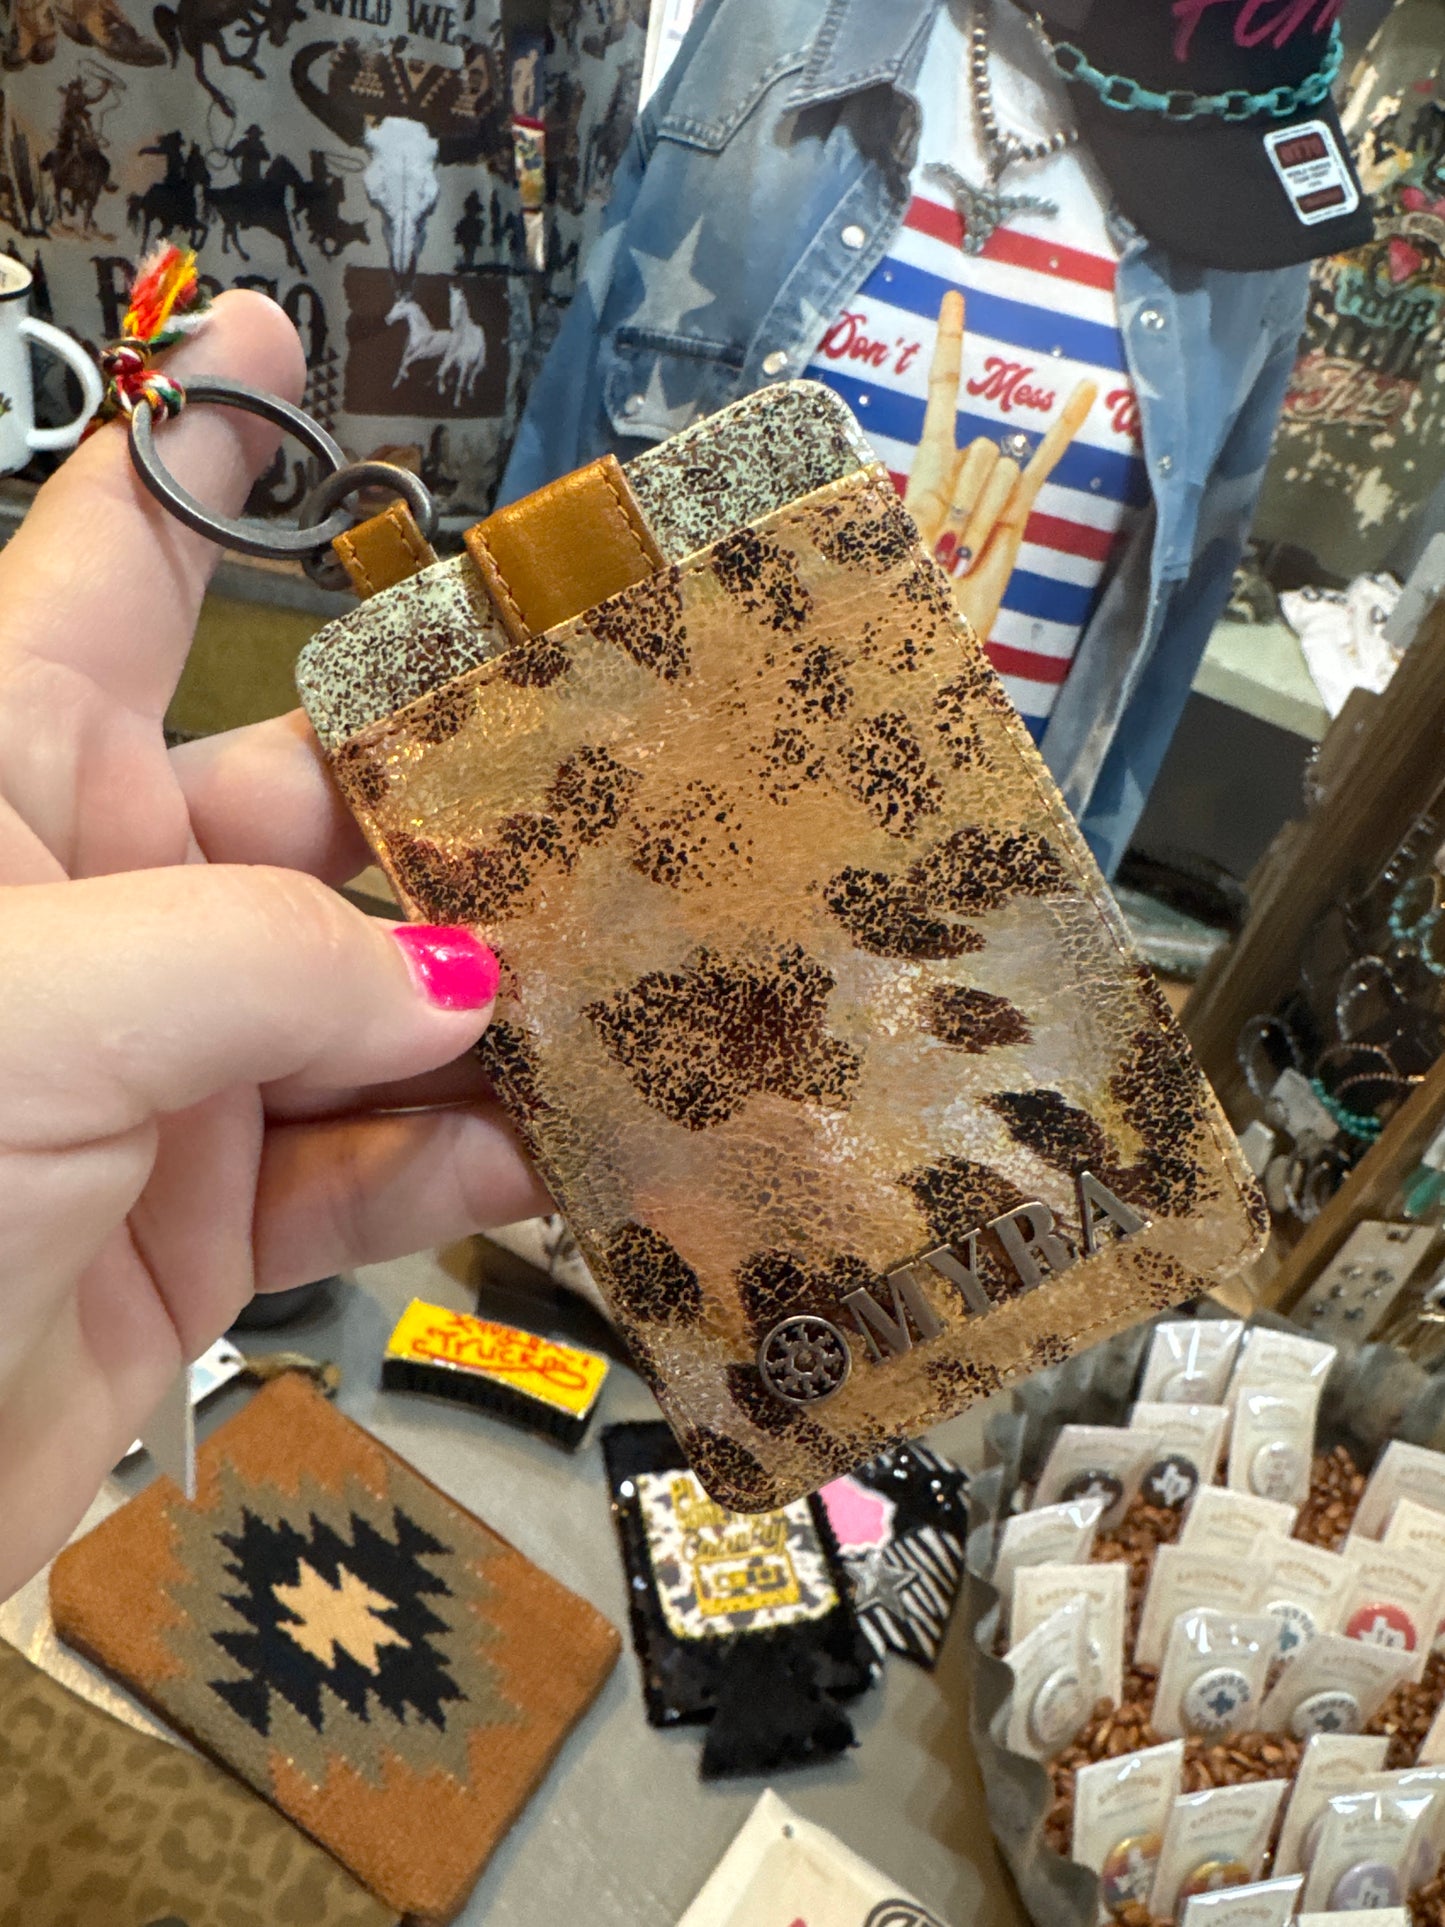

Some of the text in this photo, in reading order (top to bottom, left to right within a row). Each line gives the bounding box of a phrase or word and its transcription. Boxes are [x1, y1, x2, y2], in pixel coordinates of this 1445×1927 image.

[816, 309, 921, 376] Don't
[966, 356, 1055, 414] Mess
[840, 1171, 1153, 1367] MYRA
